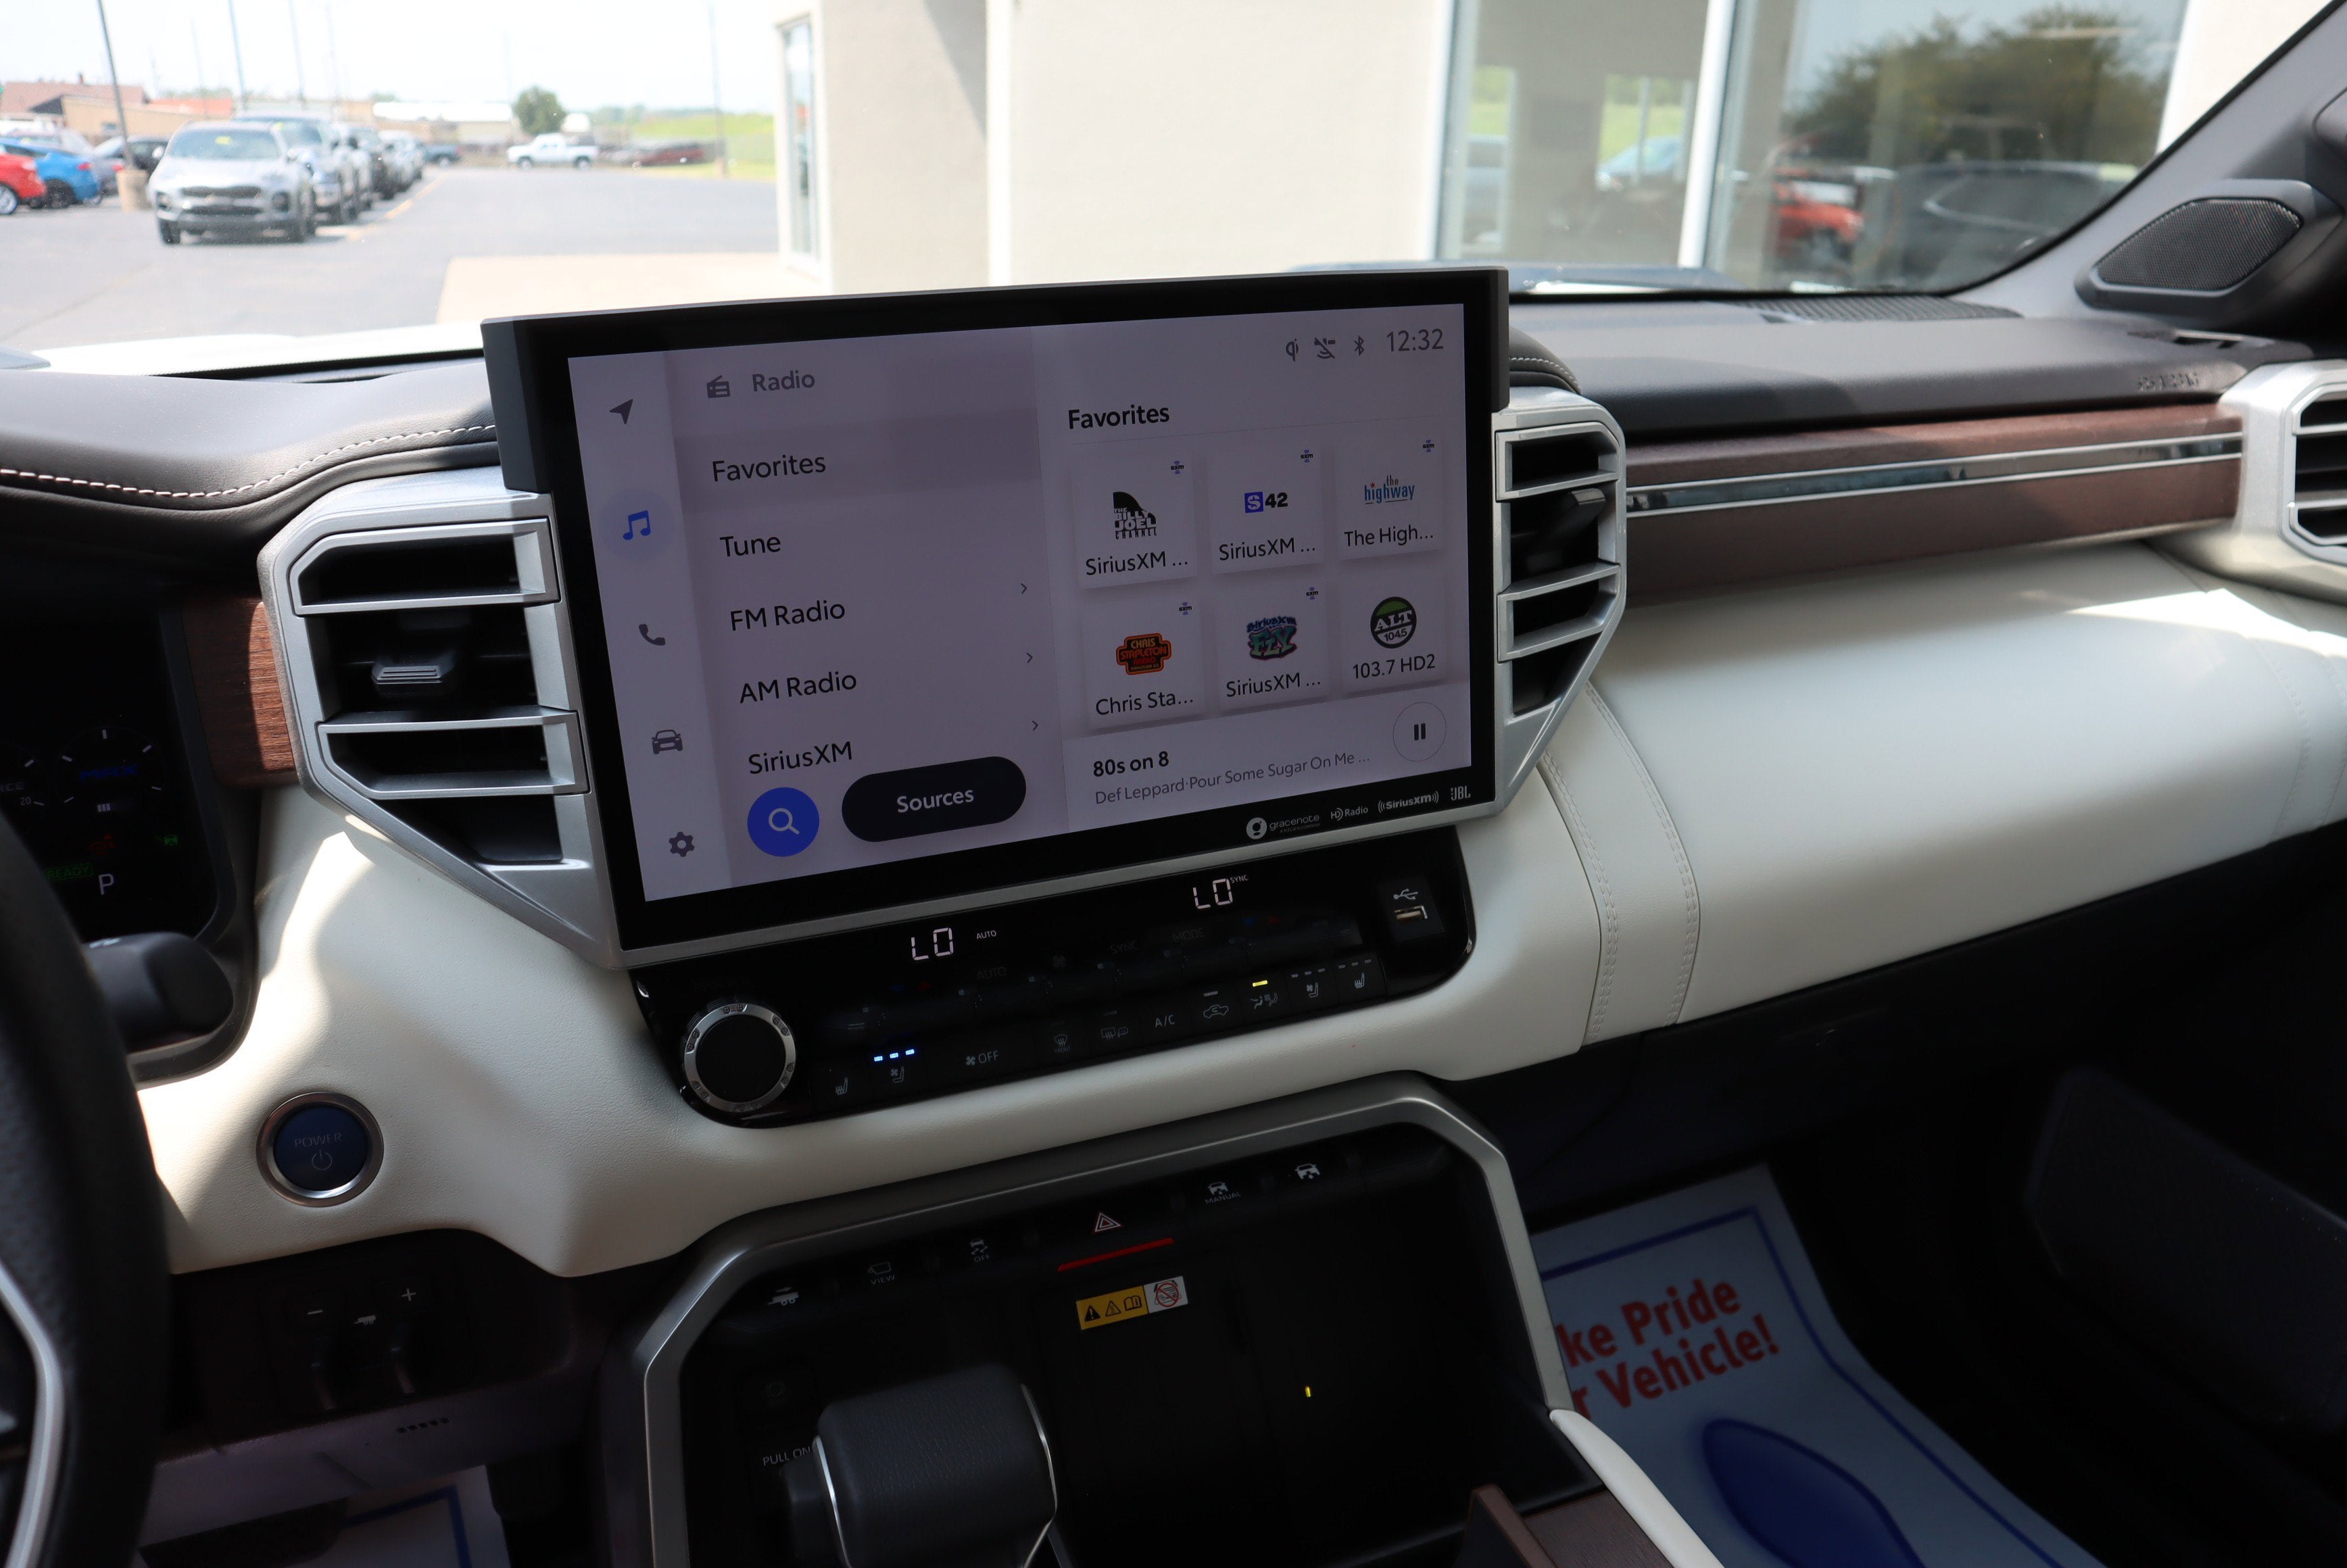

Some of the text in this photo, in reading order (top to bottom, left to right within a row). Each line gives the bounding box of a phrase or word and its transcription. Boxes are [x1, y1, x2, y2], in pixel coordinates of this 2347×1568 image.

[1386, 328, 1444, 352] 12:32
[752, 370, 816, 392] Radio
[1069, 404, 1170, 429] Favorites
[712, 454, 827, 482] Favorites
[1385, 474, 1399, 487] the
[1265, 492, 1288, 508] 42
[1364, 482, 1415, 504] highway
[1115, 510, 1149, 521] BILLY
[1115, 518, 1157, 531] JOEL
[1115, 527, 1157, 540] CHANNEL
[1344, 530, 1375, 547] The
[720, 534, 781, 557] Tune
[1219, 537, 1295, 561] SiriusXM
[1086, 551, 1167, 576] SiriusXM
[730, 600, 845, 631] FM Radio
[1374, 610, 1412, 631] ALT
[1131, 638, 1156, 649] CHRIS
[1249, 626, 1297, 658] FLY
[1121, 646, 1167, 660] STAPLETON
[1353, 654, 1436, 680] 103.7 HD2
[740, 672, 857, 704] AM Radio
[1226, 673, 1301, 697] SiriusXM
[1096, 693, 1142, 716] Chris
[748, 741, 853, 775] SiriusXM
[1093, 751, 1169, 777] 80s on 8
[1095, 787, 1121, 805] Def
[1226, 766, 1264, 784] Some
[1268, 761, 1308, 781] Sugar
[1311, 756, 1331, 770] On
[1334, 752, 1355, 766] Me
[20, 797, 31, 806] 20
[897, 789, 975, 813] Sources
[1451, 785, 1471, 801] JBL
[1345, 806, 1368, 817] Radio
[1269, 814, 1320, 831] gracenote
[47, 866, 90, 879] READY
[1230, 875, 1249, 883] SYNC
[99, 874, 114, 895] P
[1193, 878, 1233, 909] LO
[911, 927, 954, 961] LO
[976, 930, 997, 939] AUTO
[1155, 1014, 1176, 1027] A/C
[978, 1050, 998, 1064] OFF
[294, 1132, 341, 1148] POWER
[1205, 1192, 1242, 1204] MANUAL
[973, 1254, 990, 1263] OFF
[871, 1274, 895, 1285] VIEW
[1557, 1279, 1741, 1368] ke Pride
[1597, 1314, 1780, 1409] Vehicle!
[763, 1452, 790, 1467] PULL
